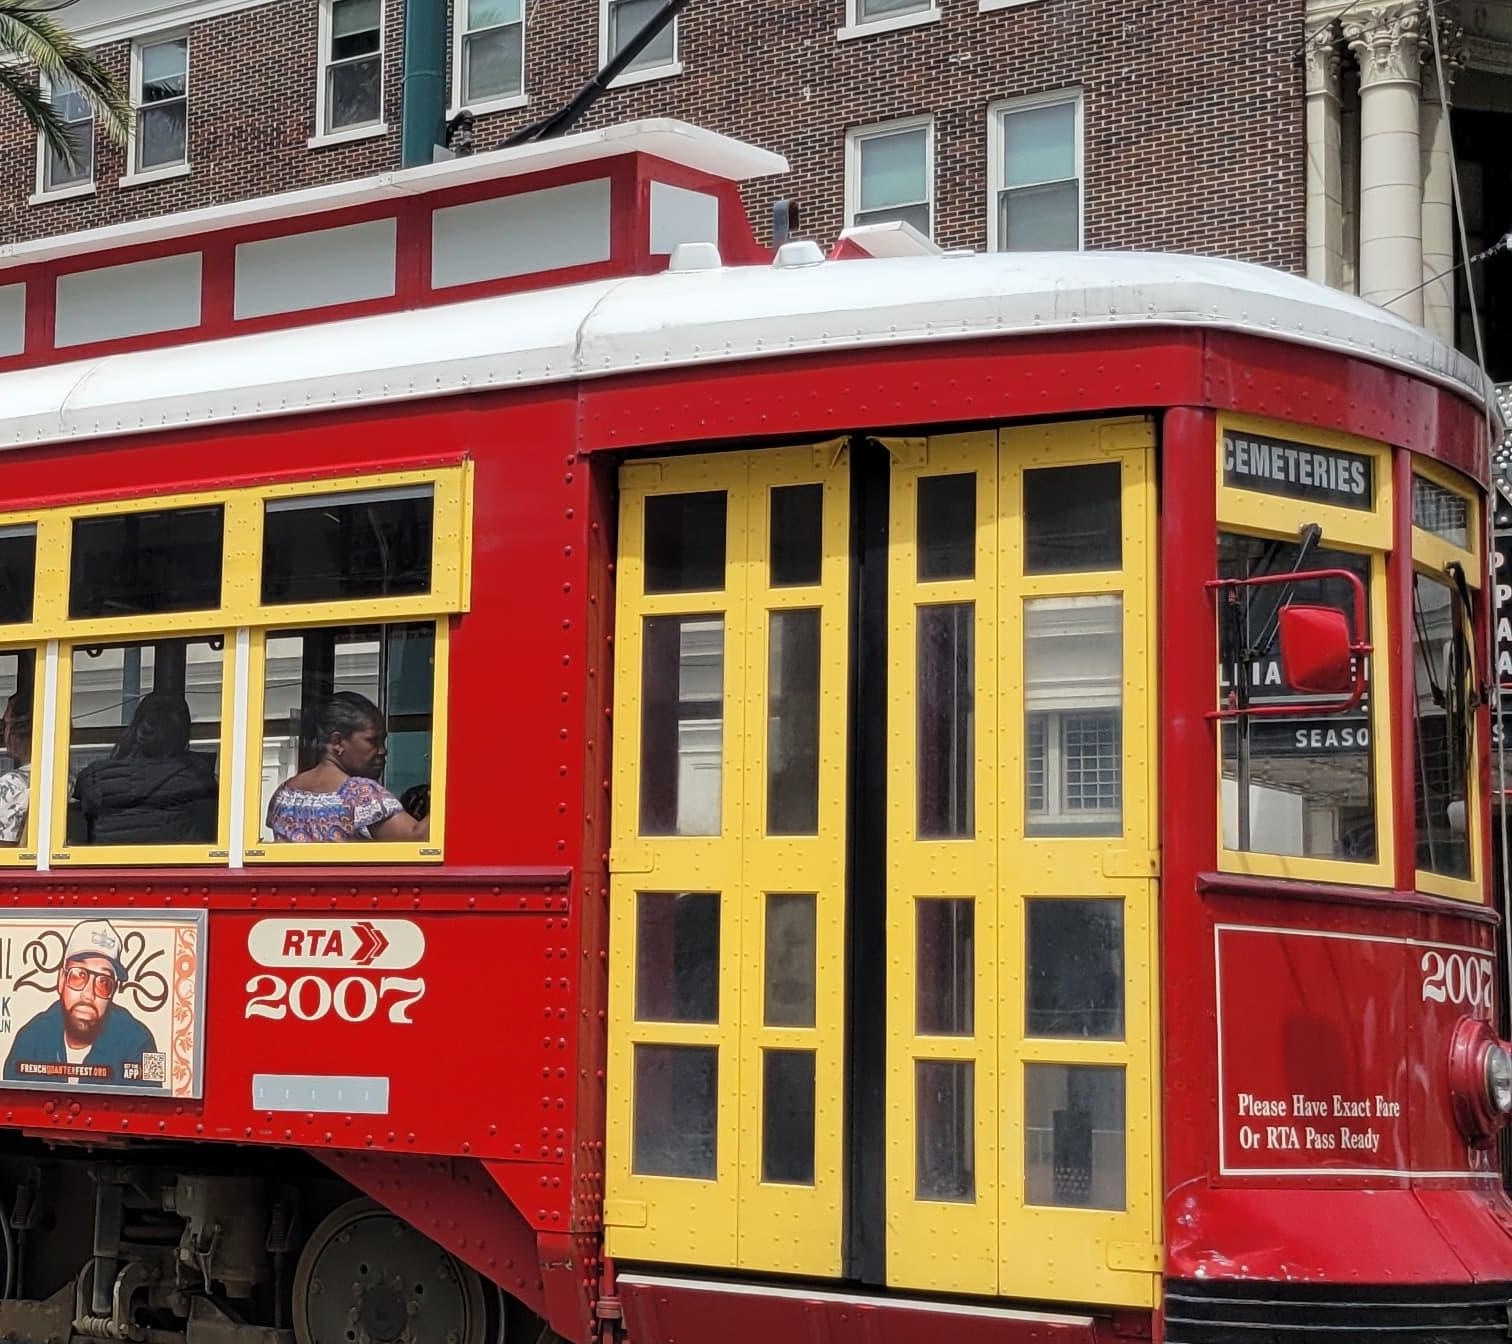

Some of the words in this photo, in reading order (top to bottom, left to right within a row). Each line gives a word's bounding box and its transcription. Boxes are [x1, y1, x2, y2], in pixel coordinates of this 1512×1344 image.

[1223, 437, 1366, 495] CEMETERIES
[282, 929, 344, 957] RTA
[1421, 951, 1493, 1008] 2007
[245, 974, 426, 1024] 2007
[124, 1068, 139, 1079] APP
[1238, 1093, 1287, 1117] Please
[1292, 1094, 1328, 1117] Have
[1333, 1094, 1371, 1117] Exact
[1375, 1095, 1400, 1118] Fare
[1239, 1126, 1260, 1149] Or
[1267, 1126, 1300, 1149] RTA
[1305, 1127, 1335, 1149] Pass
[1341, 1127, 1380, 1152] Ready
